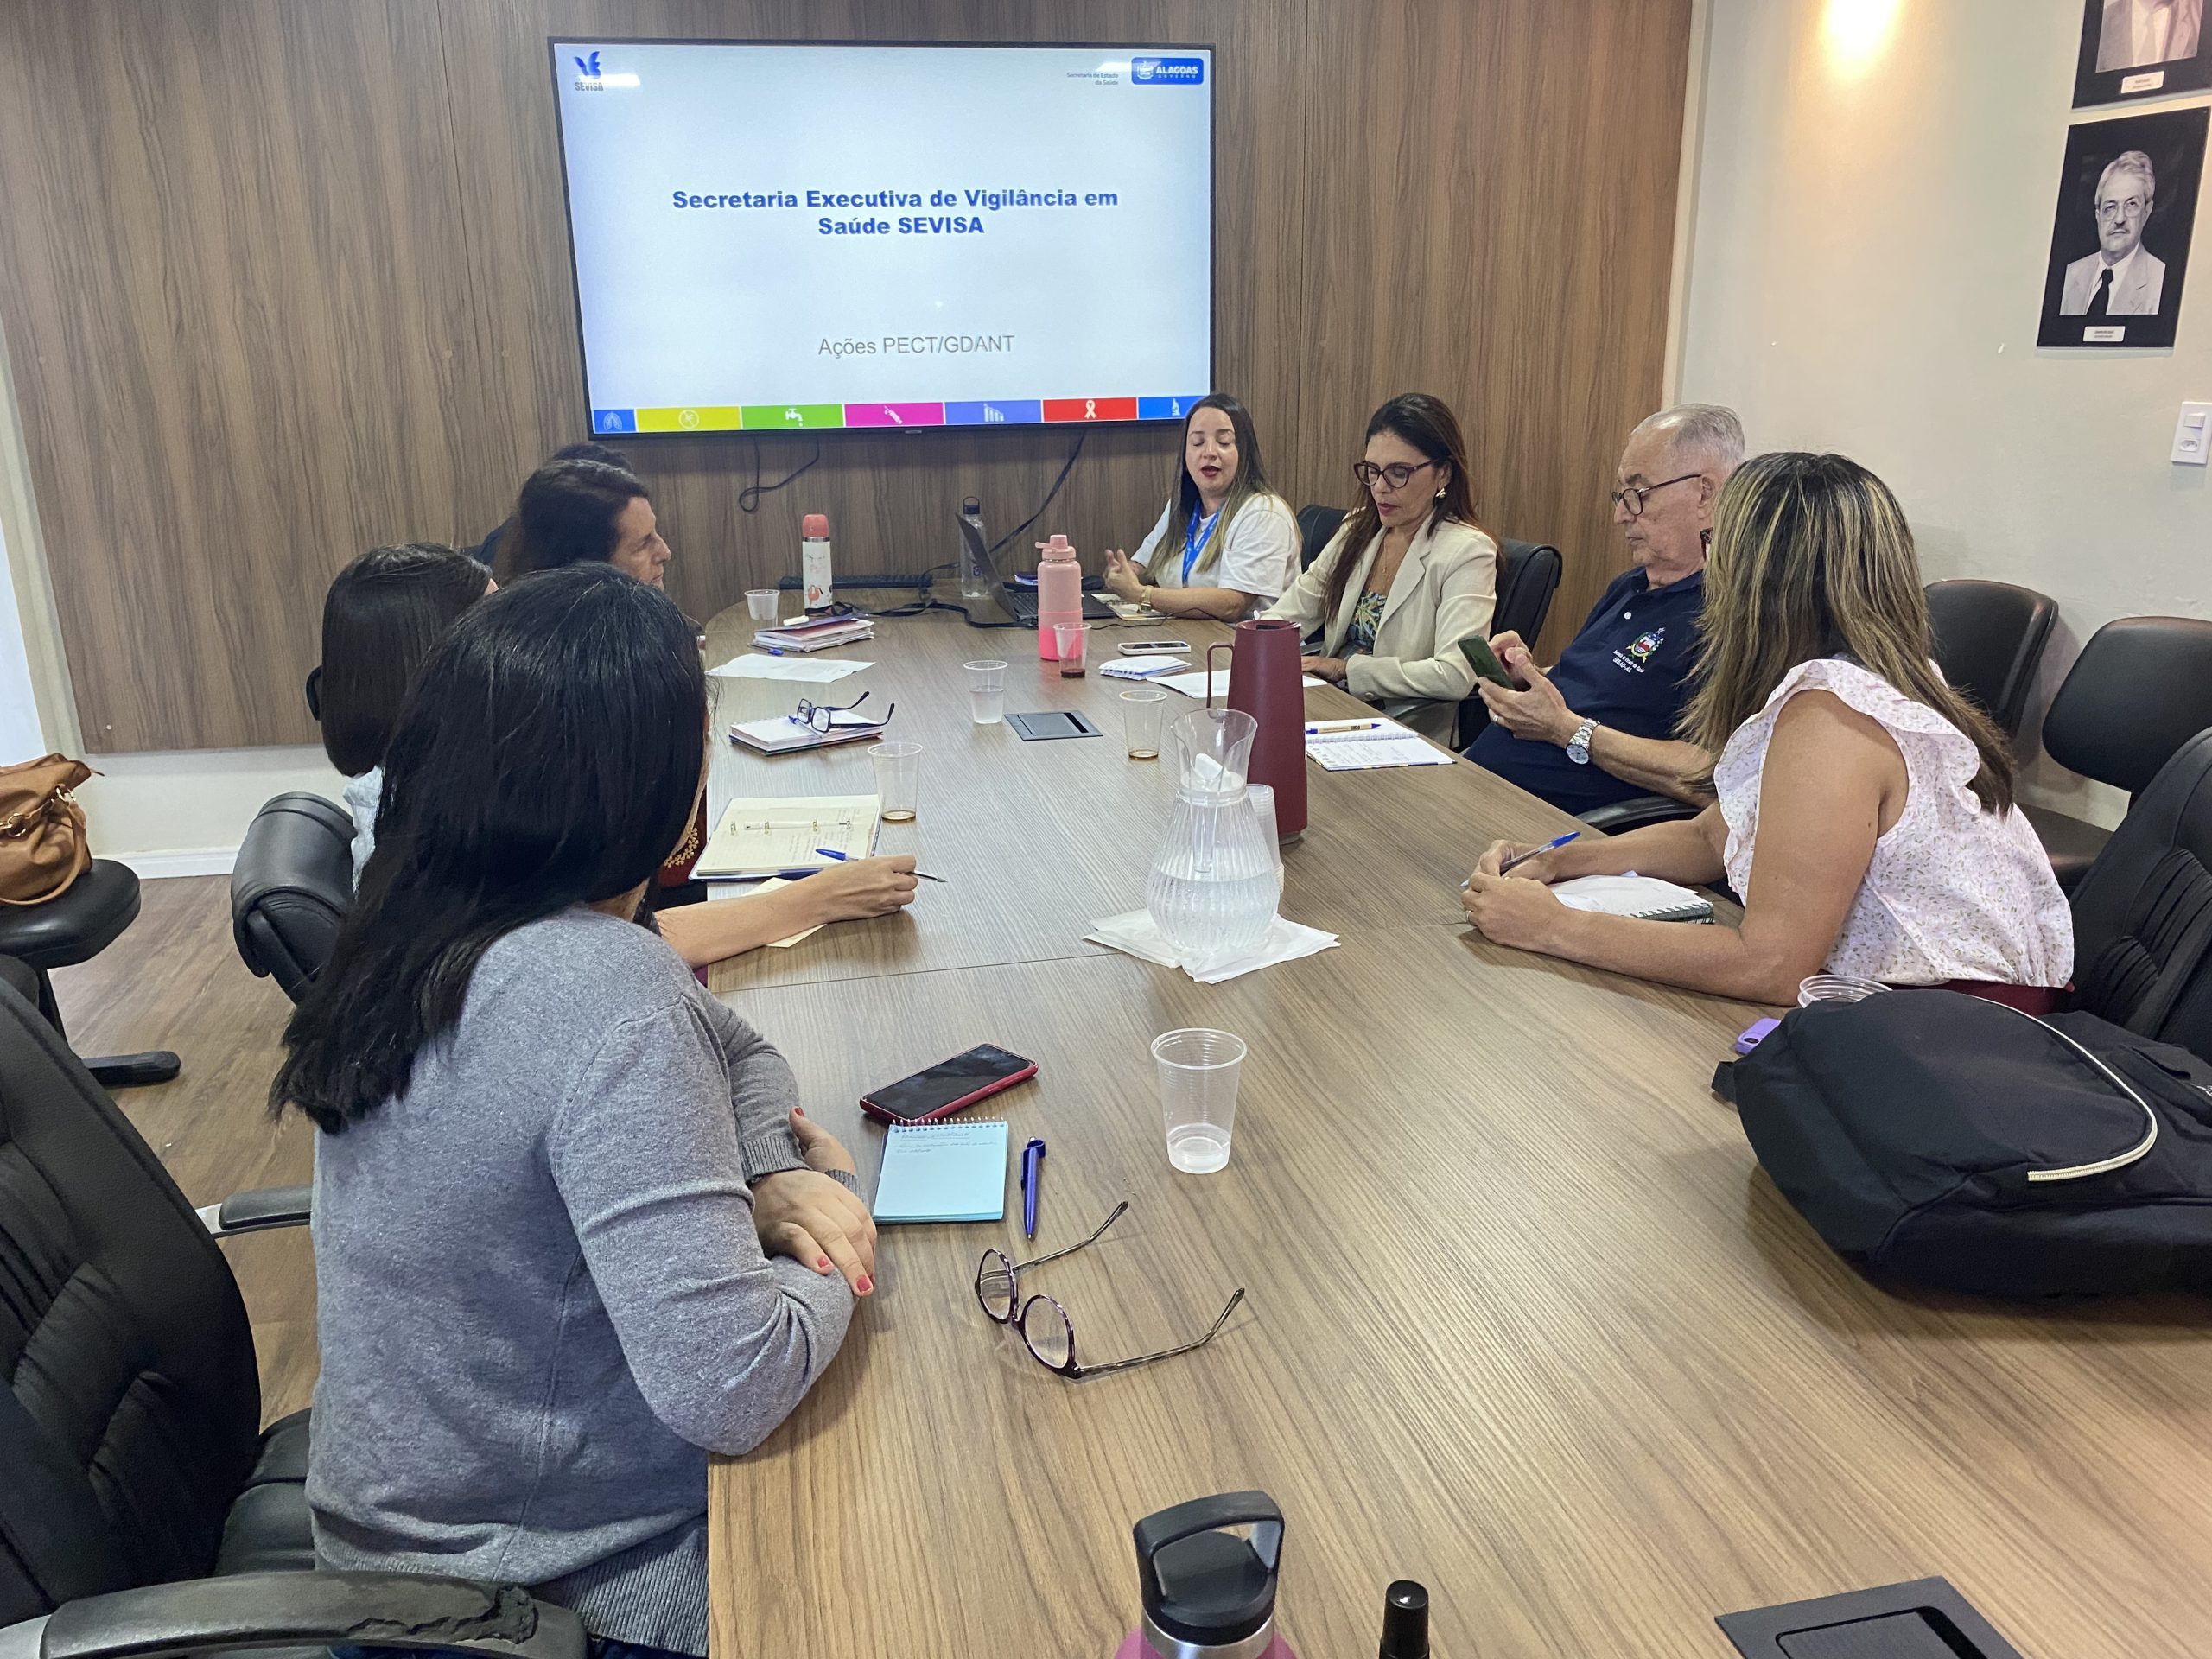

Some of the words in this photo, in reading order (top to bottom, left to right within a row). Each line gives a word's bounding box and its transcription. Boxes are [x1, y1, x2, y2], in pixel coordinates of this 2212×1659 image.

[1155, 66, 1198, 74] ALAGOAS
[575, 81, 604, 92] SEVISA
[672, 190, 798, 208] Secretaria
[806, 189, 923, 208] Executiva
[930, 189, 957, 207] de
[964, 188, 1077, 212] Vigilância
[1084, 192, 1118, 207] em
[817, 216, 891, 235] Saúde
[897, 216, 985, 234] SEVISA
[817, 337, 877, 359] Ações
[882, 334, 1015, 354] PECT/GDANT
